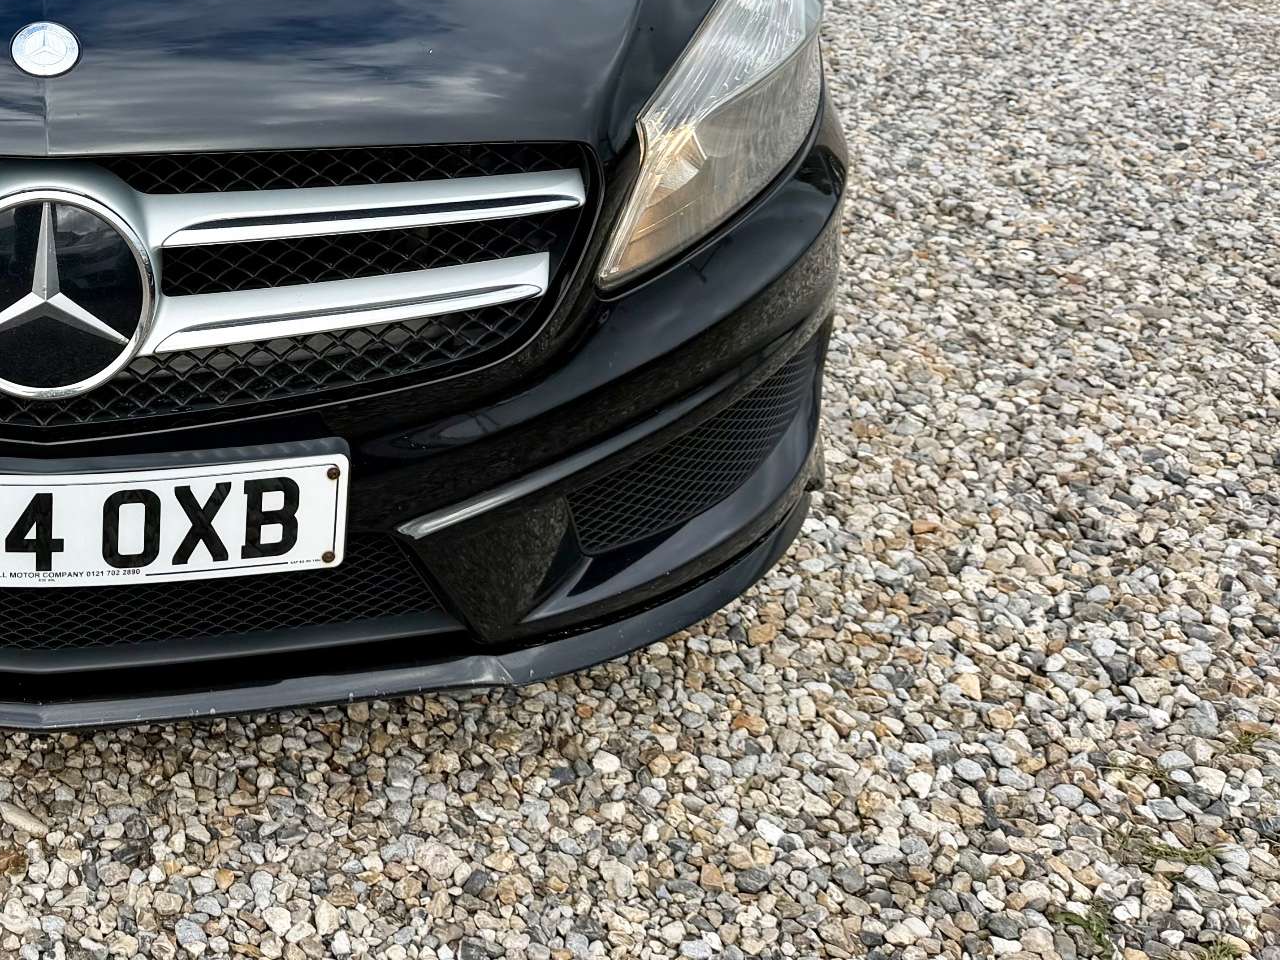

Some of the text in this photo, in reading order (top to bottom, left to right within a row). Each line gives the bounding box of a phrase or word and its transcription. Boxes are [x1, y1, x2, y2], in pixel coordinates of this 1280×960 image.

[102, 476, 300, 569] OXB
[9, 571, 40, 579] MOTOR
[42, 571, 84, 579] COMPANY
